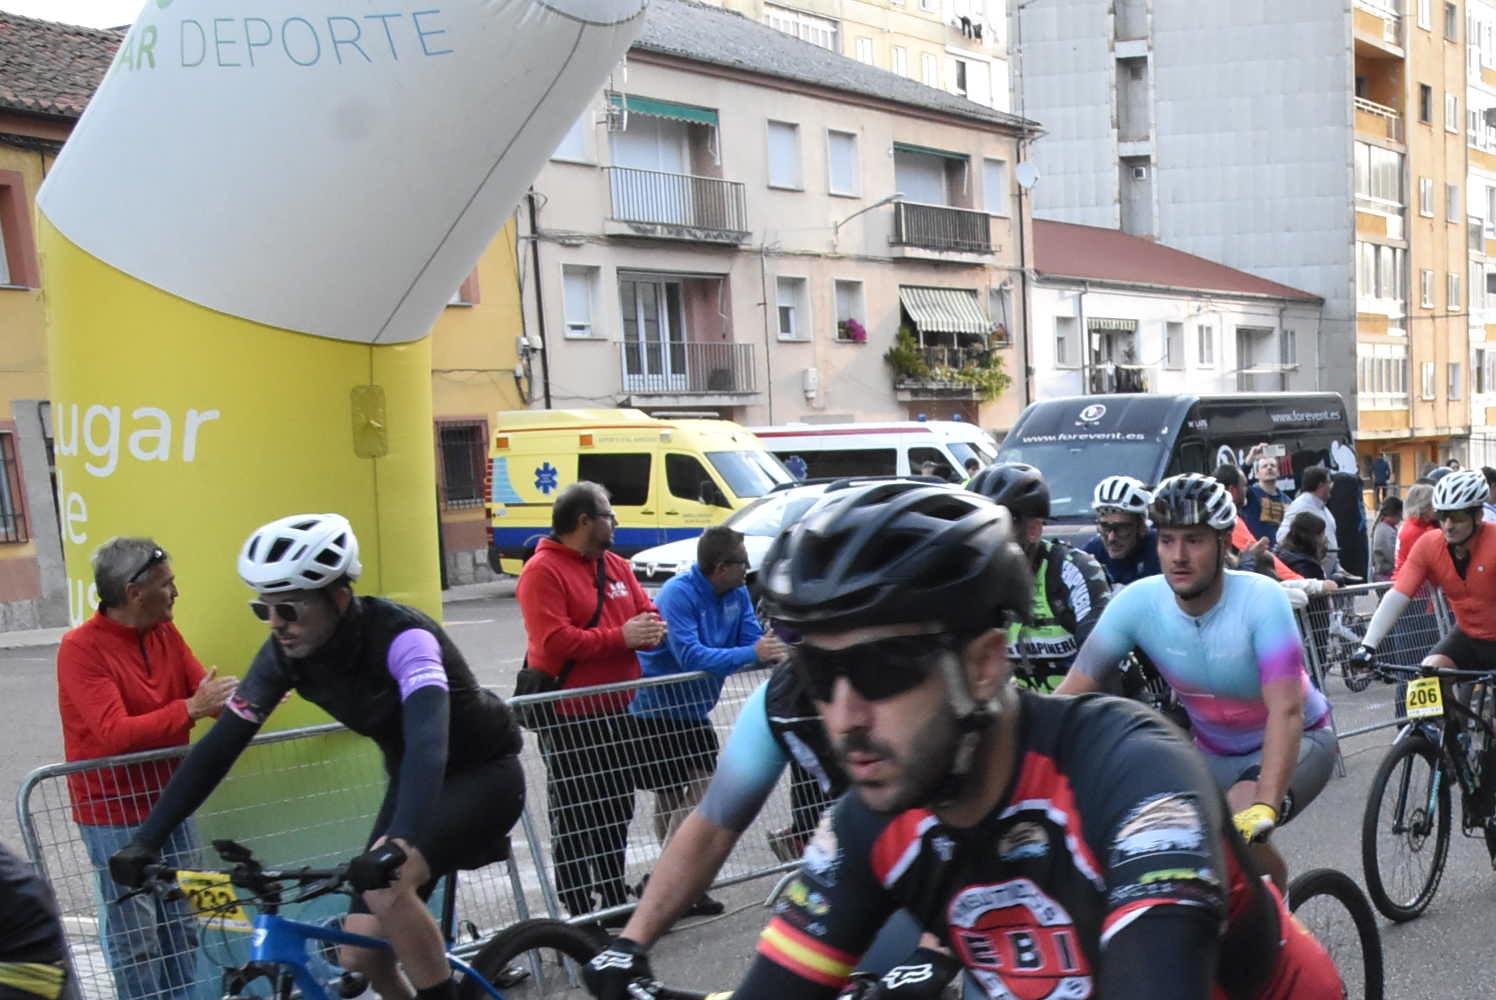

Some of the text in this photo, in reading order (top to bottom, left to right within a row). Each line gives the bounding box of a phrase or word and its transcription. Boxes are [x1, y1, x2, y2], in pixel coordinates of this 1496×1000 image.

[180, 10, 454, 67] DEPORTE
[54, 402, 221, 478] ugar
[1410, 688, 1437, 706] 206
